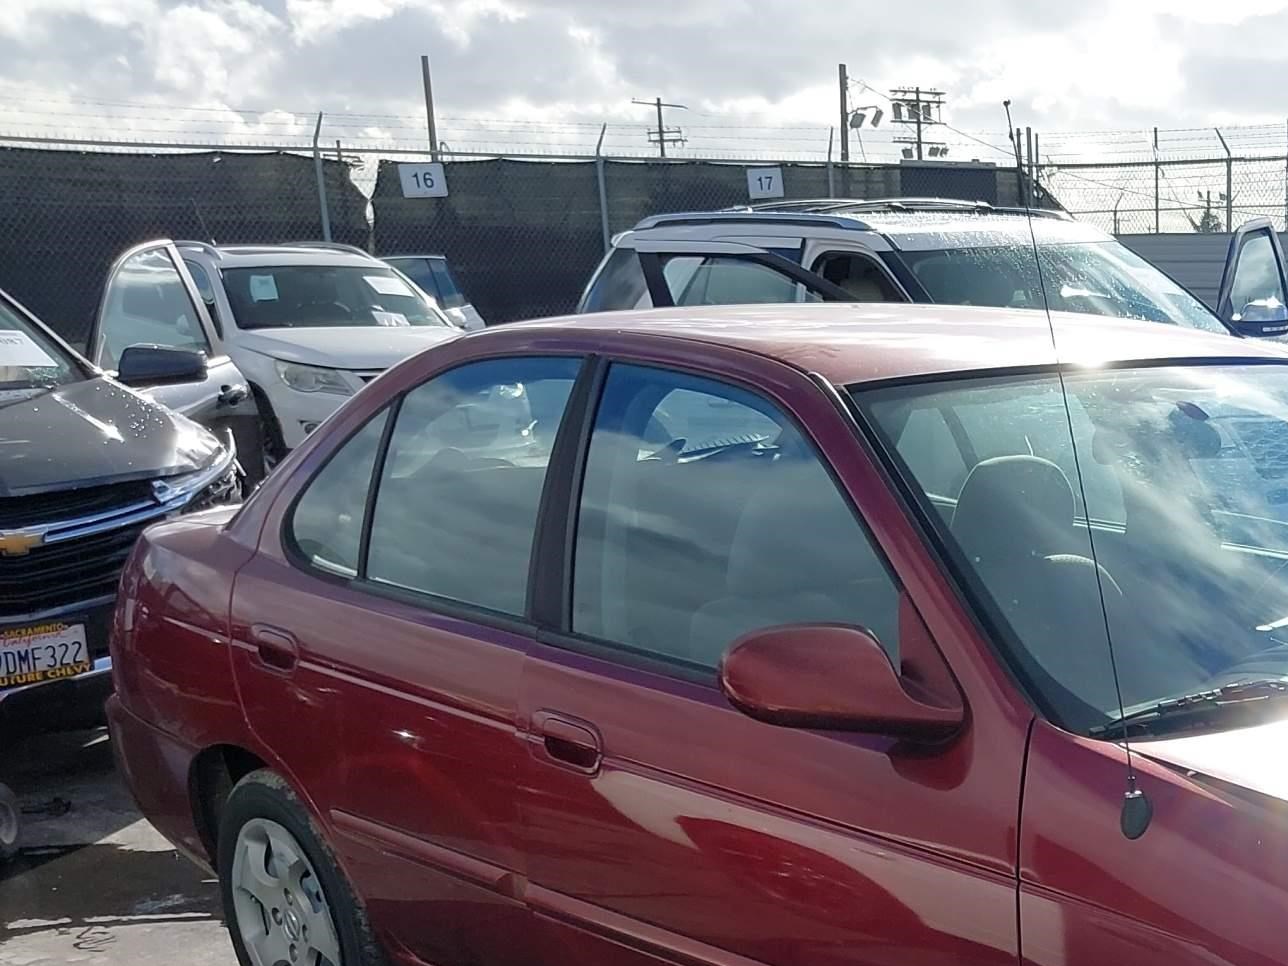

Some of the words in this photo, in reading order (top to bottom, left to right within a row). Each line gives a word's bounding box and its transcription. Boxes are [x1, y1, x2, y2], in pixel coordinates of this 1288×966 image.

[411, 171, 434, 189] 16
[757, 176, 773, 191] 17
[4, 623, 64, 638] SACRAMENTO
[0, 640, 83, 675] DMF322
[47, 663, 90, 678] CHEVY
